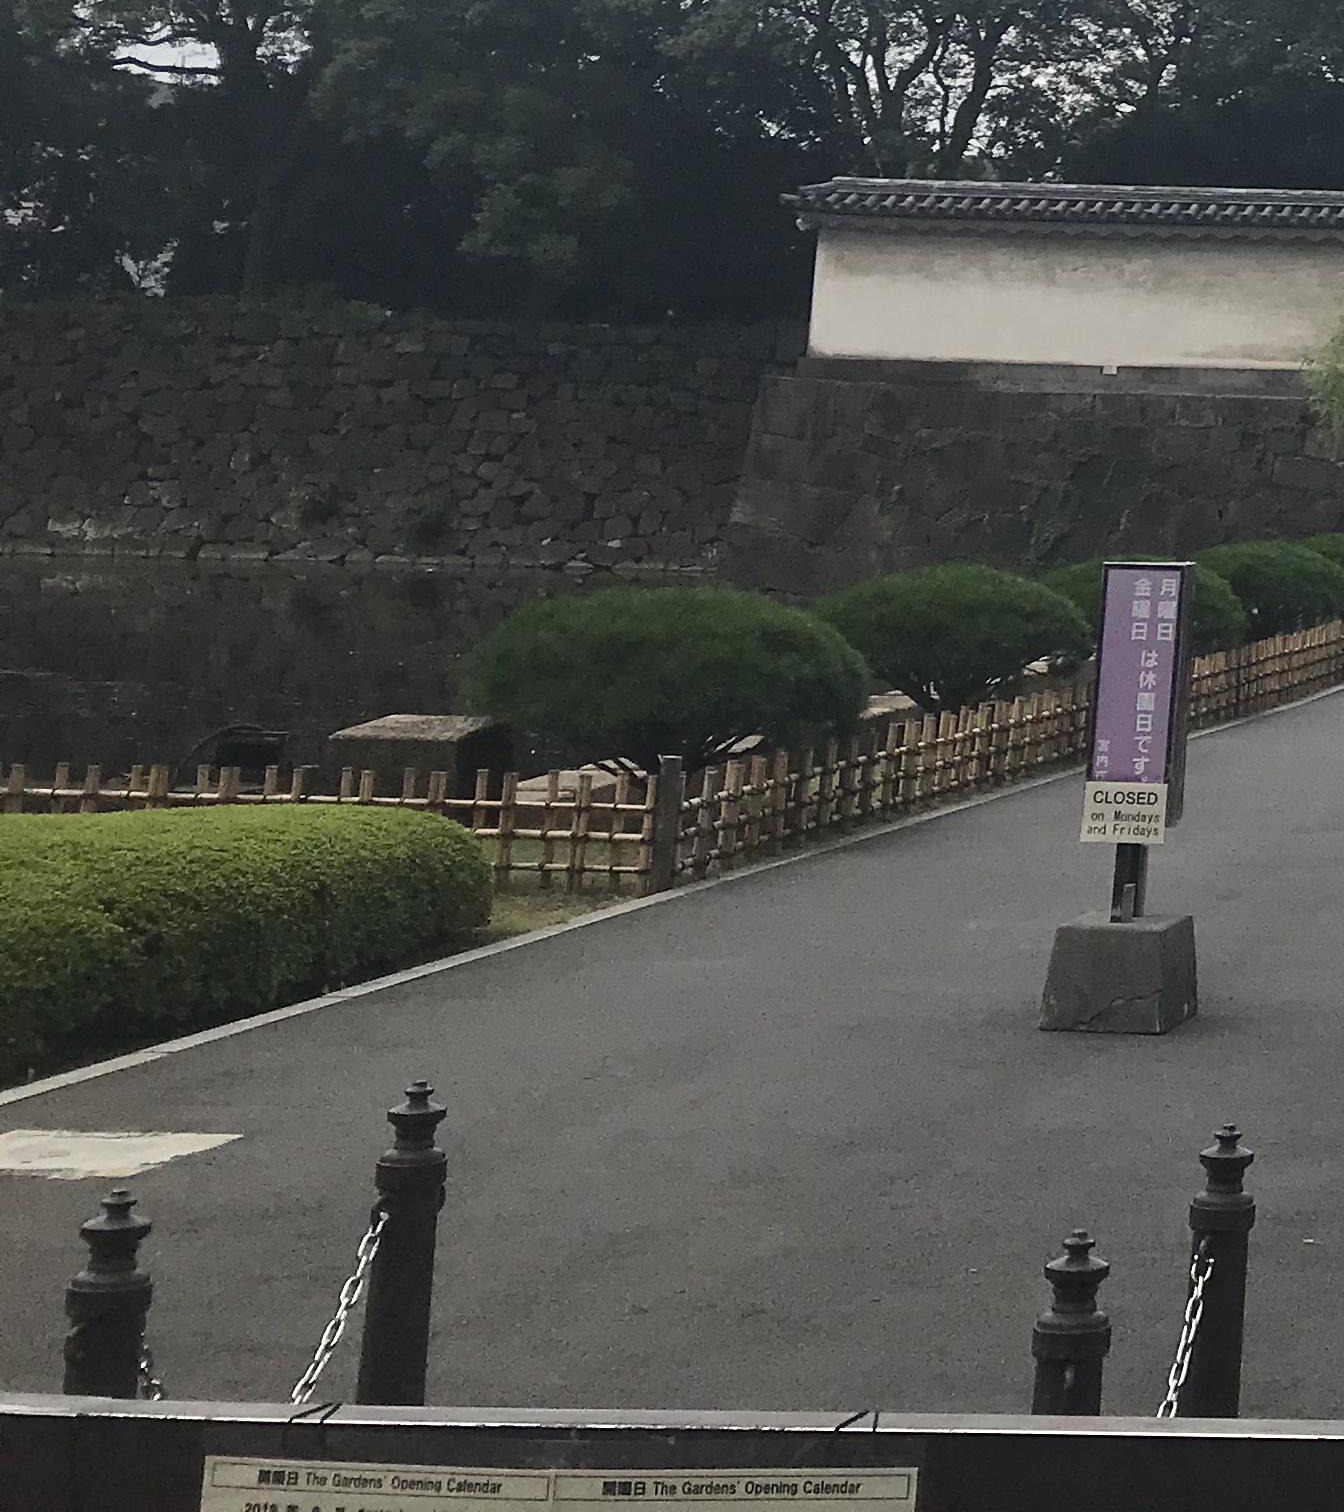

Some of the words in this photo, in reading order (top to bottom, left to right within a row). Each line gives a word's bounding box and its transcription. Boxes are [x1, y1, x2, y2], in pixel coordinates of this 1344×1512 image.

[1131, 578, 1152, 641] 金曜日
[1157, 578, 1177, 641] 月曜日
[1093, 790, 1158, 806] CLOSED
[1091, 812, 1104, 821] on
[1113, 810, 1160, 824] Mondays
[1087, 824, 1106, 835] and
[1112, 823, 1159, 838] Fridays
[306, 1472, 328, 1486] The
[391, 1475, 442, 1494] Opening
[446, 1477, 503, 1494] Calendar
[653, 1481, 677, 1496] The
[744, 1480, 798, 1496] Opening
[802, 1480, 863, 1495] Calendar
